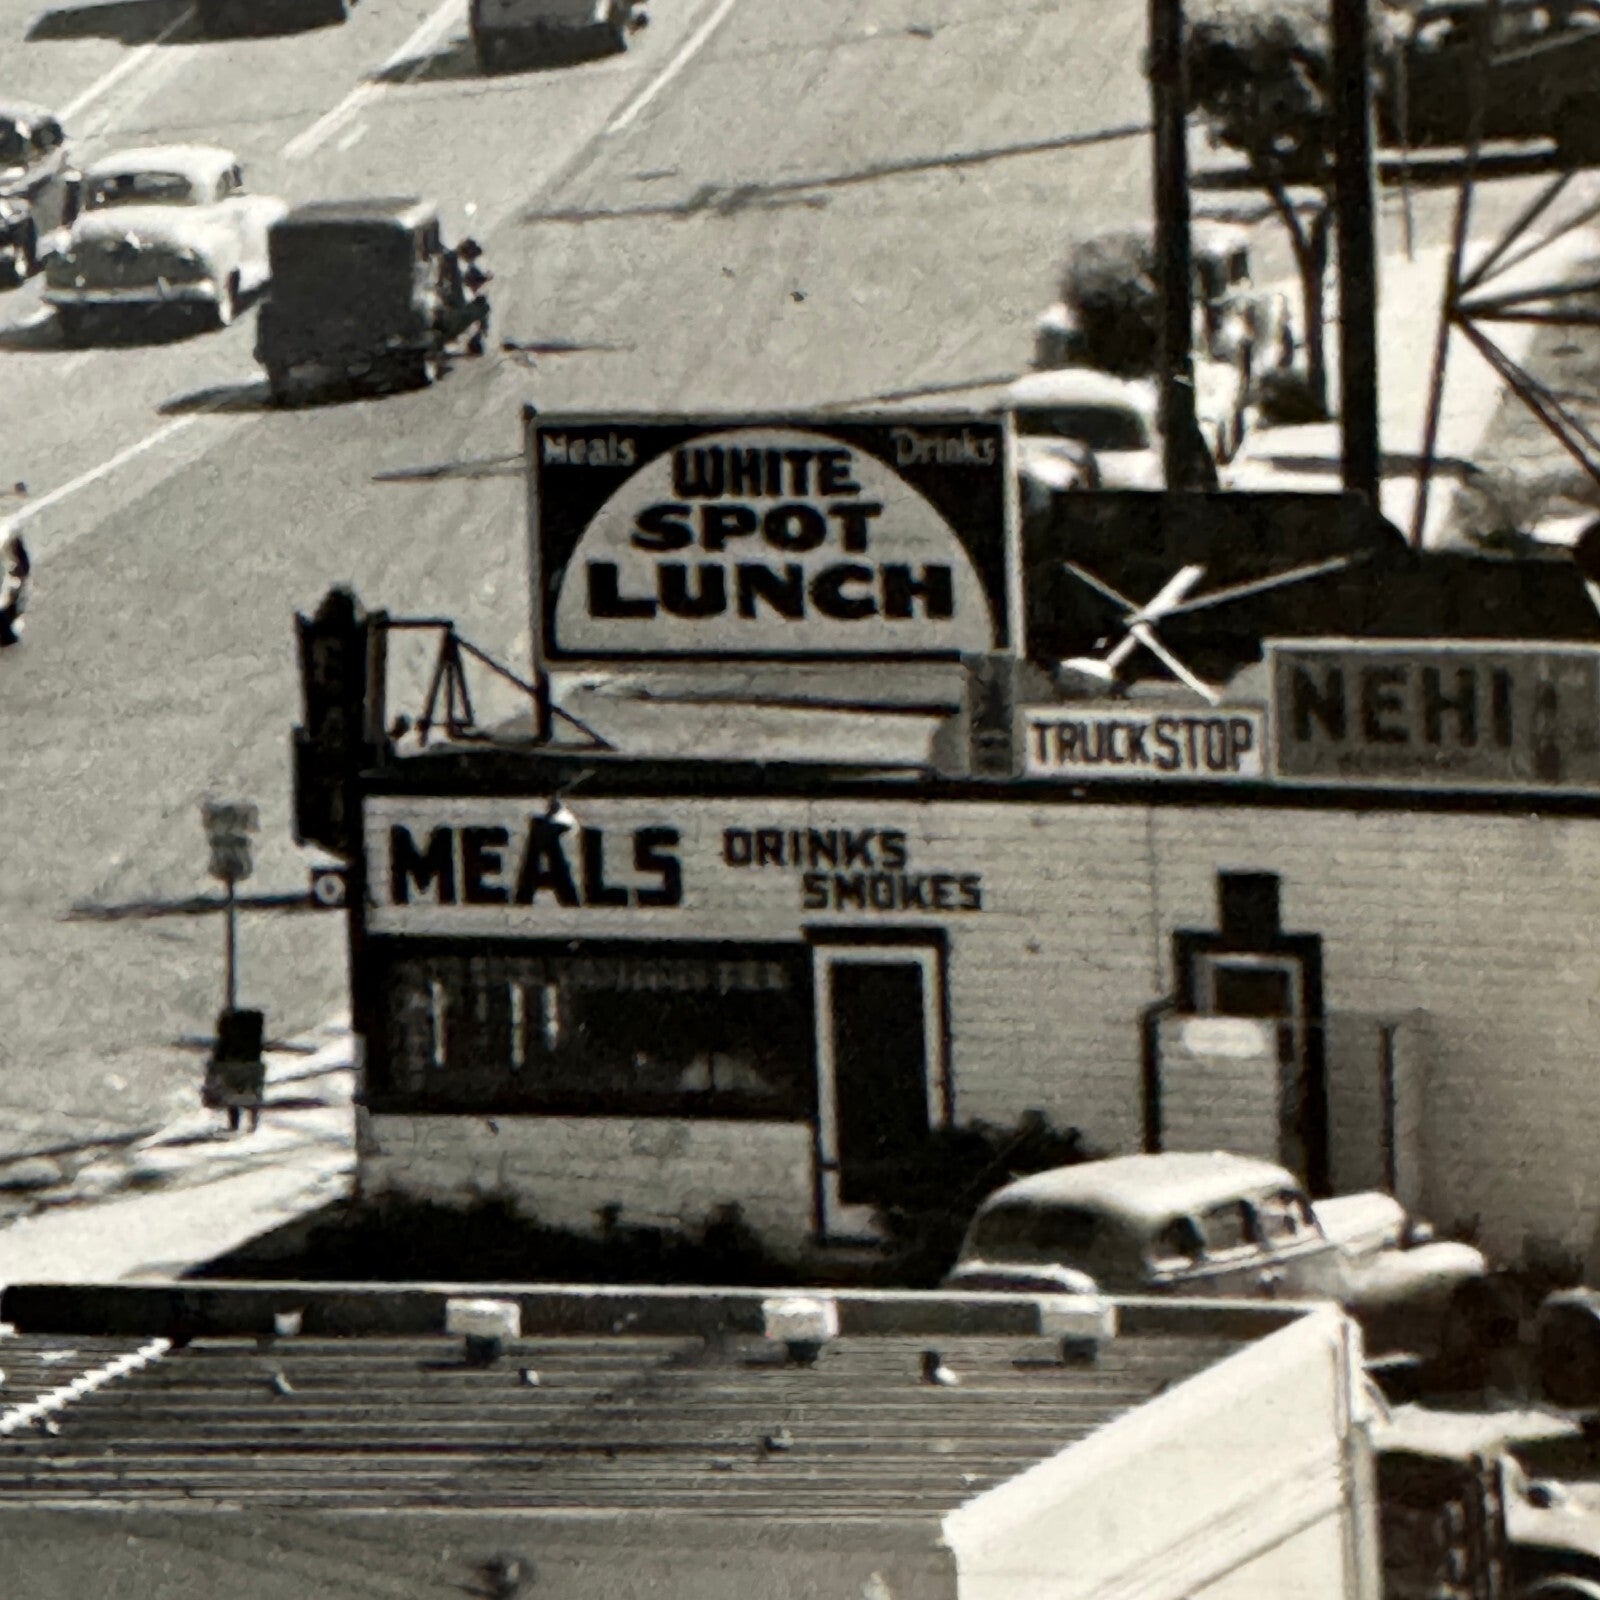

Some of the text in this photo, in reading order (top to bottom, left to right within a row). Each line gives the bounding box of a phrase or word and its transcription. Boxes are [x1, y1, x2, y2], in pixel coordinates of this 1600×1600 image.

[543, 432, 636, 466] Meals
[889, 427, 995, 466] Drinks
[671, 446, 861, 499] WHITE
[631, 503, 882, 553] SPOT
[586, 562, 953, 620] LUNCH
[1293, 665, 1512, 748] NEHI
[389, 815, 682, 907] MEALS
[723, 828, 906, 868] DRINKS
[802, 872, 983, 911] SMOKES
